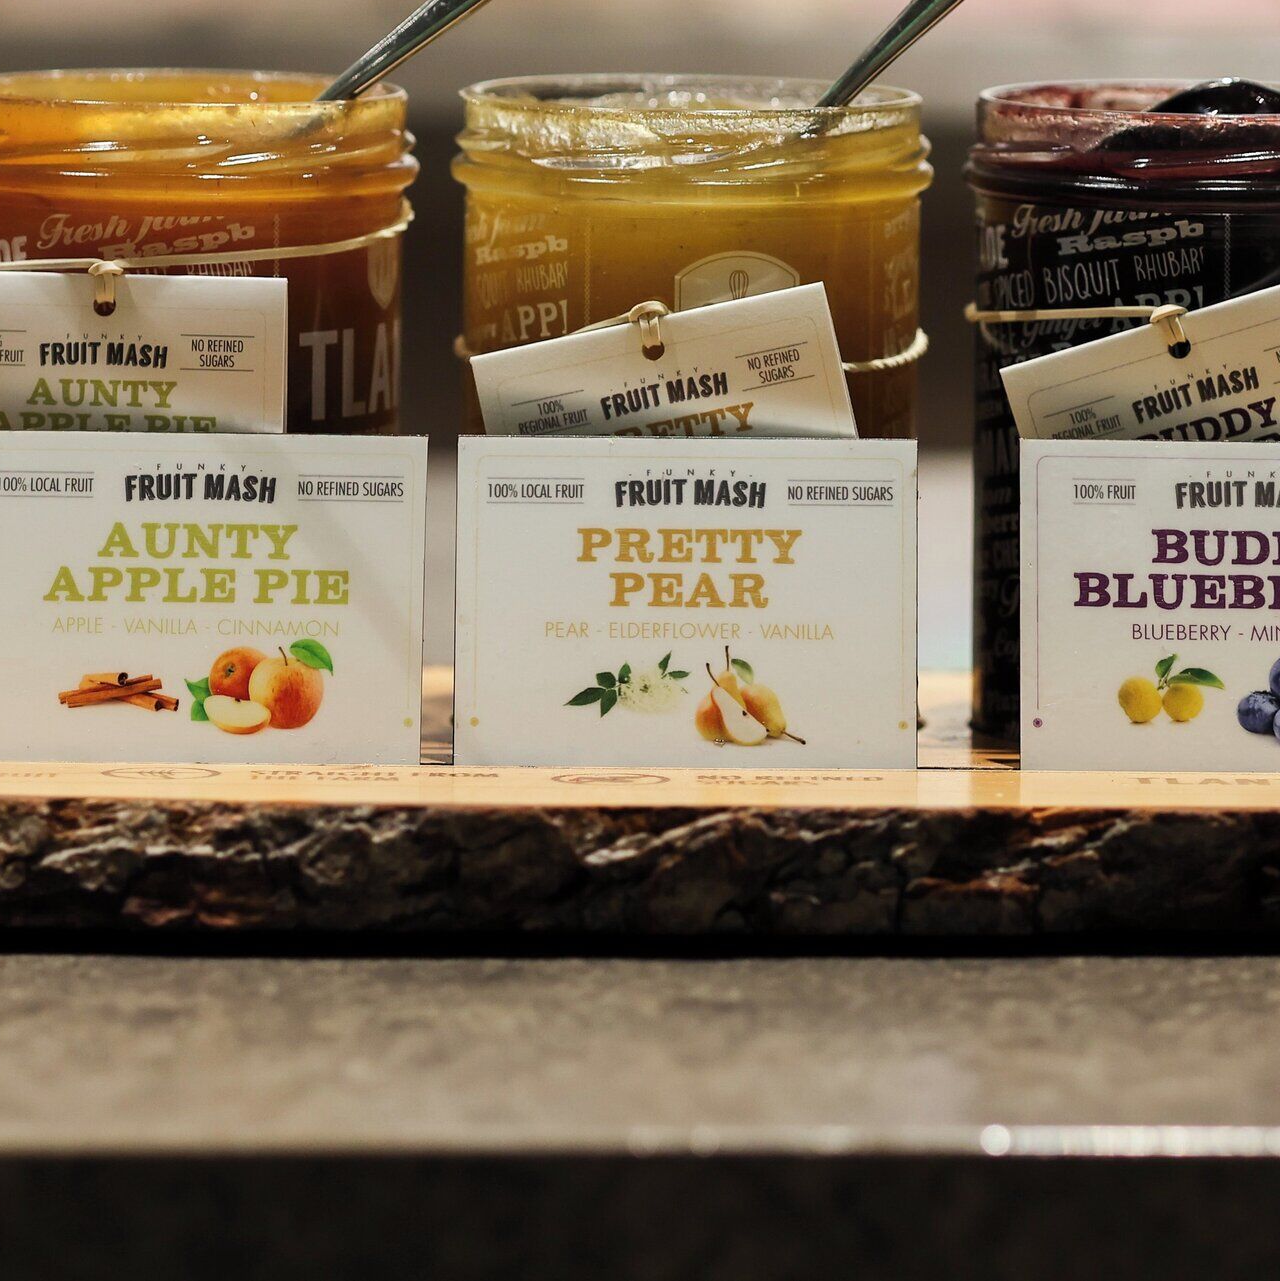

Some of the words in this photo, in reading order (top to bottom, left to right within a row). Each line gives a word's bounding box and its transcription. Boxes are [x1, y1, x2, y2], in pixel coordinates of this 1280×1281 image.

[0, 349, 23, 362] FRUIT
[40, 342, 101, 366] FRUIT
[106, 342, 168, 369] MASH
[191, 339, 205, 352] NO
[207, 339, 244, 353] REFINED
[199, 354, 235, 368] SUGARS
[747, 357, 761, 371] NO
[763, 349, 800, 367] REFINED
[759, 365, 795, 384] SUGARS
[26, 378, 177, 408] AUNTY
[600, 384, 661, 420] FRUIT
[666, 372, 729, 404] MASH
[1132, 383, 1193, 424] FRUIT
[1197, 367, 1260, 403] MASH
[537, 399, 564, 415] 100%
[1070, 407, 1097, 425] 100%
[563, 409, 588, 426] FRUIT
[1097, 413, 1121, 433] FRUIT
[156, 463, 247, 471] FUNKY
[646, 469, 737, 477] FUNKY
[30, 477, 61, 492] LOCAL
[65, 477, 94, 493] FRUIT
[124, 472, 198, 503] FRUIT
[203, 474, 277, 504] MASH
[298, 481, 313, 496] NO
[316, 481, 359, 497] REFINED
[363, 481, 404, 497] SUGARS
[487, 483, 518, 499] 100%
[521, 483, 553, 499] LOCAL
[556, 483, 584, 499] FRUIT
[615, 479, 689, 509] FRUIT
[694, 480, 766, 509] MASH
[788, 485, 803, 501] NO
[806, 486, 849, 501] REFINED
[852, 486, 893, 502] SUGARS
[1073, 484, 1104, 500] 100%
[1107, 484, 1136, 500] FRUIT
[1175, 481, 1248, 510] FRUIT
[97, 522, 299, 560] AUNTY
[576, 527, 802, 565] PRETTY
[43, 566, 236, 604] APPLE
[253, 569, 350, 605] PIE
[609, 572, 769, 609] PEAR
[52, 617, 103, 634] APPLE
[123, 618, 198, 636] VANILLA
[217, 619, 339, 637] CINNAMON
[545, 622, 589, 638] PEAR
[609, 623, 741, 639] ELDERFLOWER
[760, 624, 834, 641] VANILLA
[1132, 623, 1231, 641] BLUEBERRY
